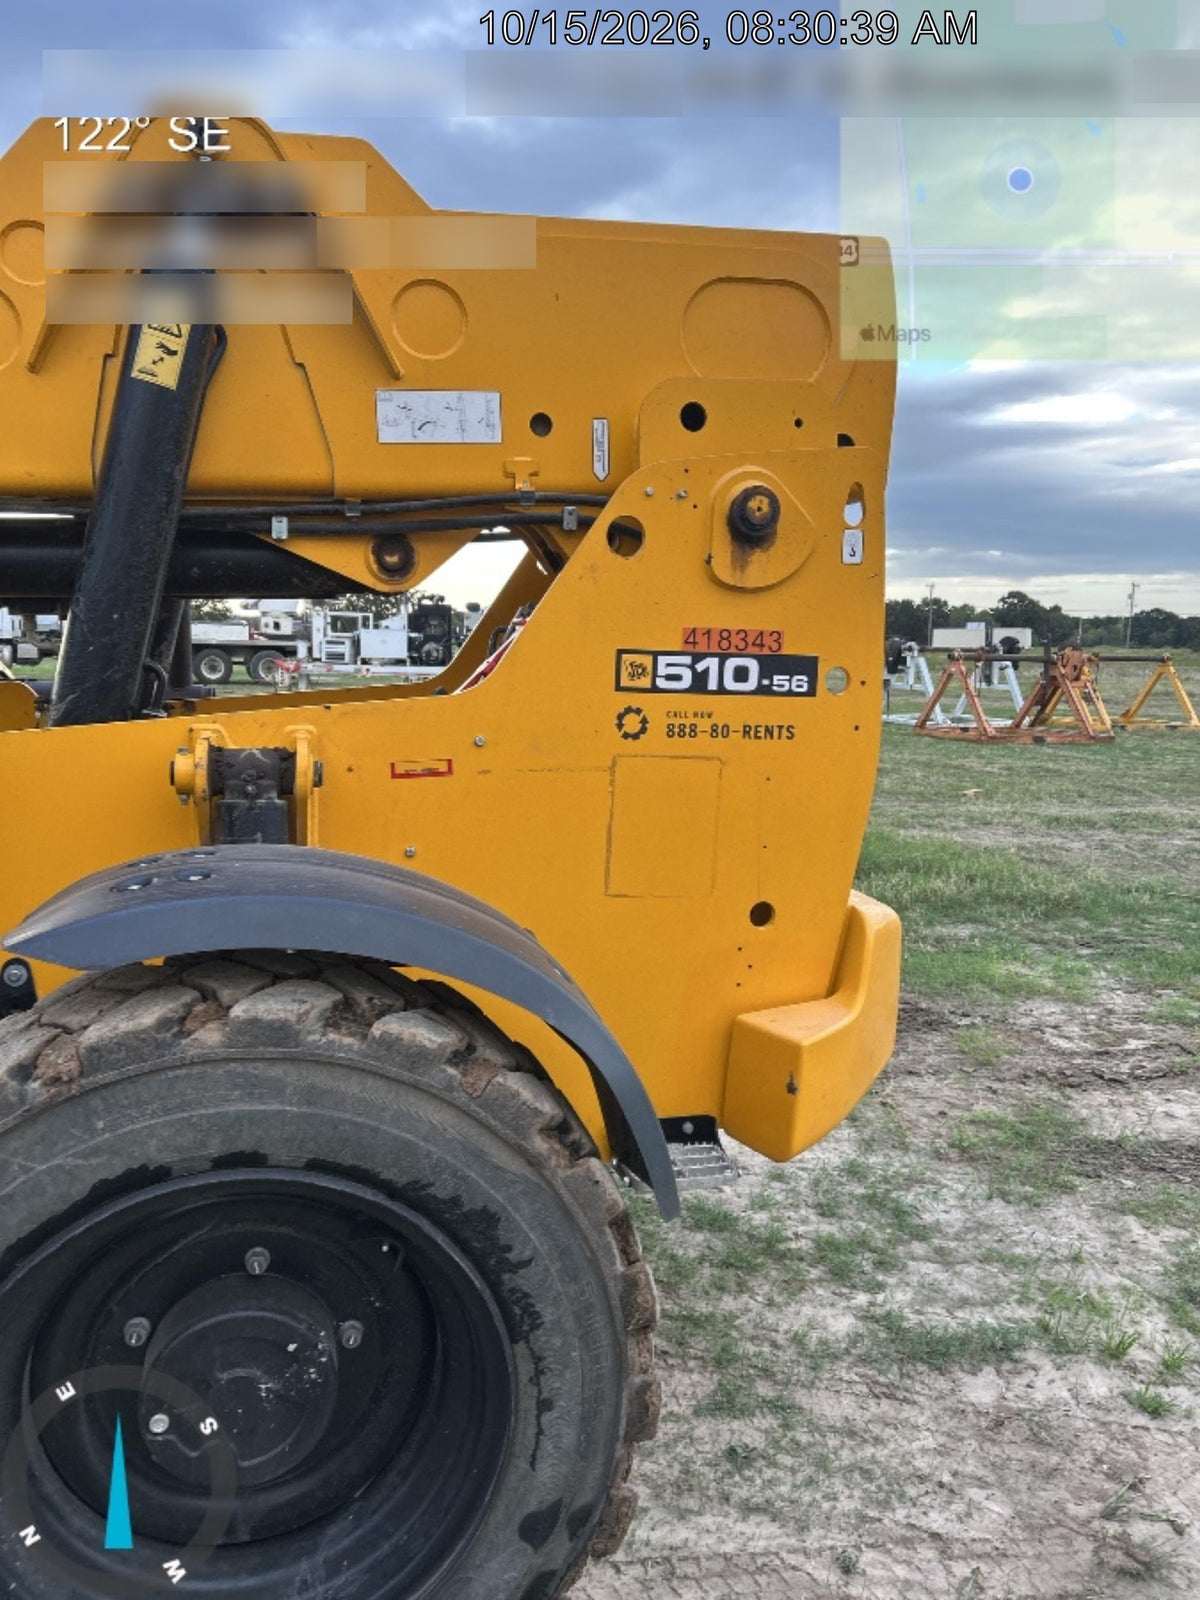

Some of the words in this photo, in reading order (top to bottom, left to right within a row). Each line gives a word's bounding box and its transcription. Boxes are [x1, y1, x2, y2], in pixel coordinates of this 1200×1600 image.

[683, 627, 783, 653] 418343
[666, 711, 689, 719] CALL
[666, 723, 796, 740] 888-80-RENTS
